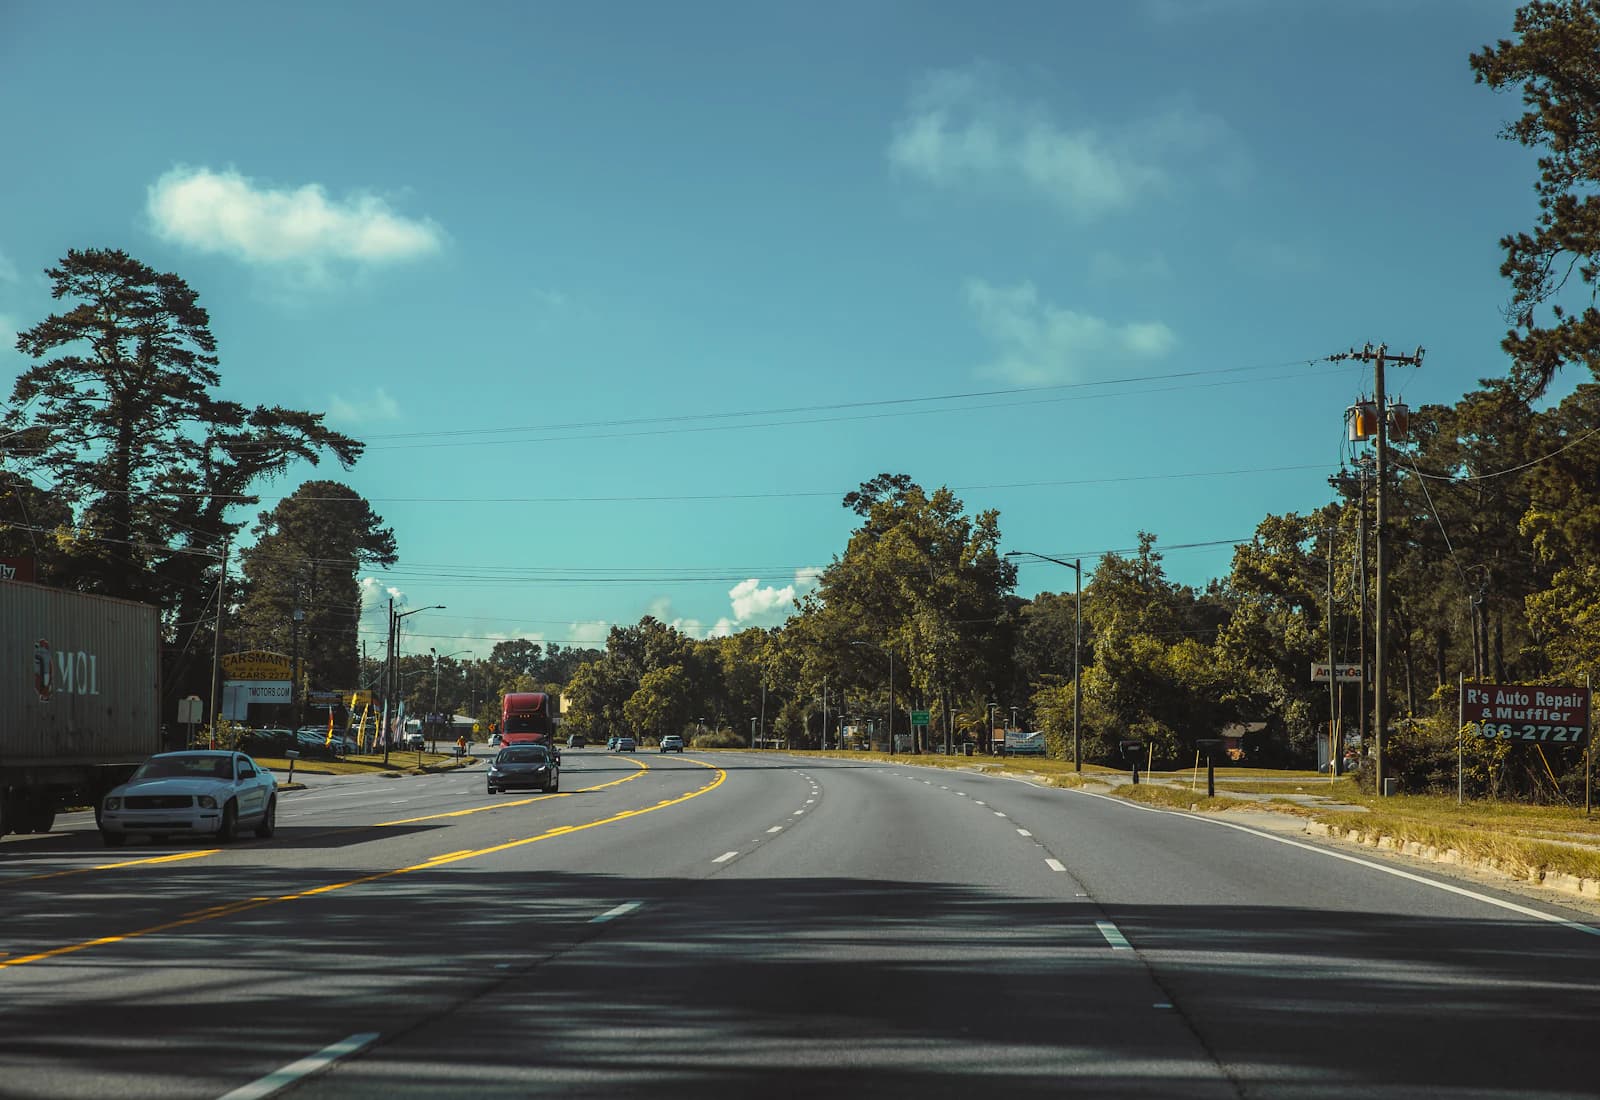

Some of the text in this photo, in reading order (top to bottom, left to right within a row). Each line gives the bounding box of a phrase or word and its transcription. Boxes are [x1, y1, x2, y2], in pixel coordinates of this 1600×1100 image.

[223, 652, 289, 667] CARSMART
[56, 650, 99, 695] MOL
[1467, 688, 1583, 710] R's Auto Repair
[1481, 707, 1571, 721] & Muffler
